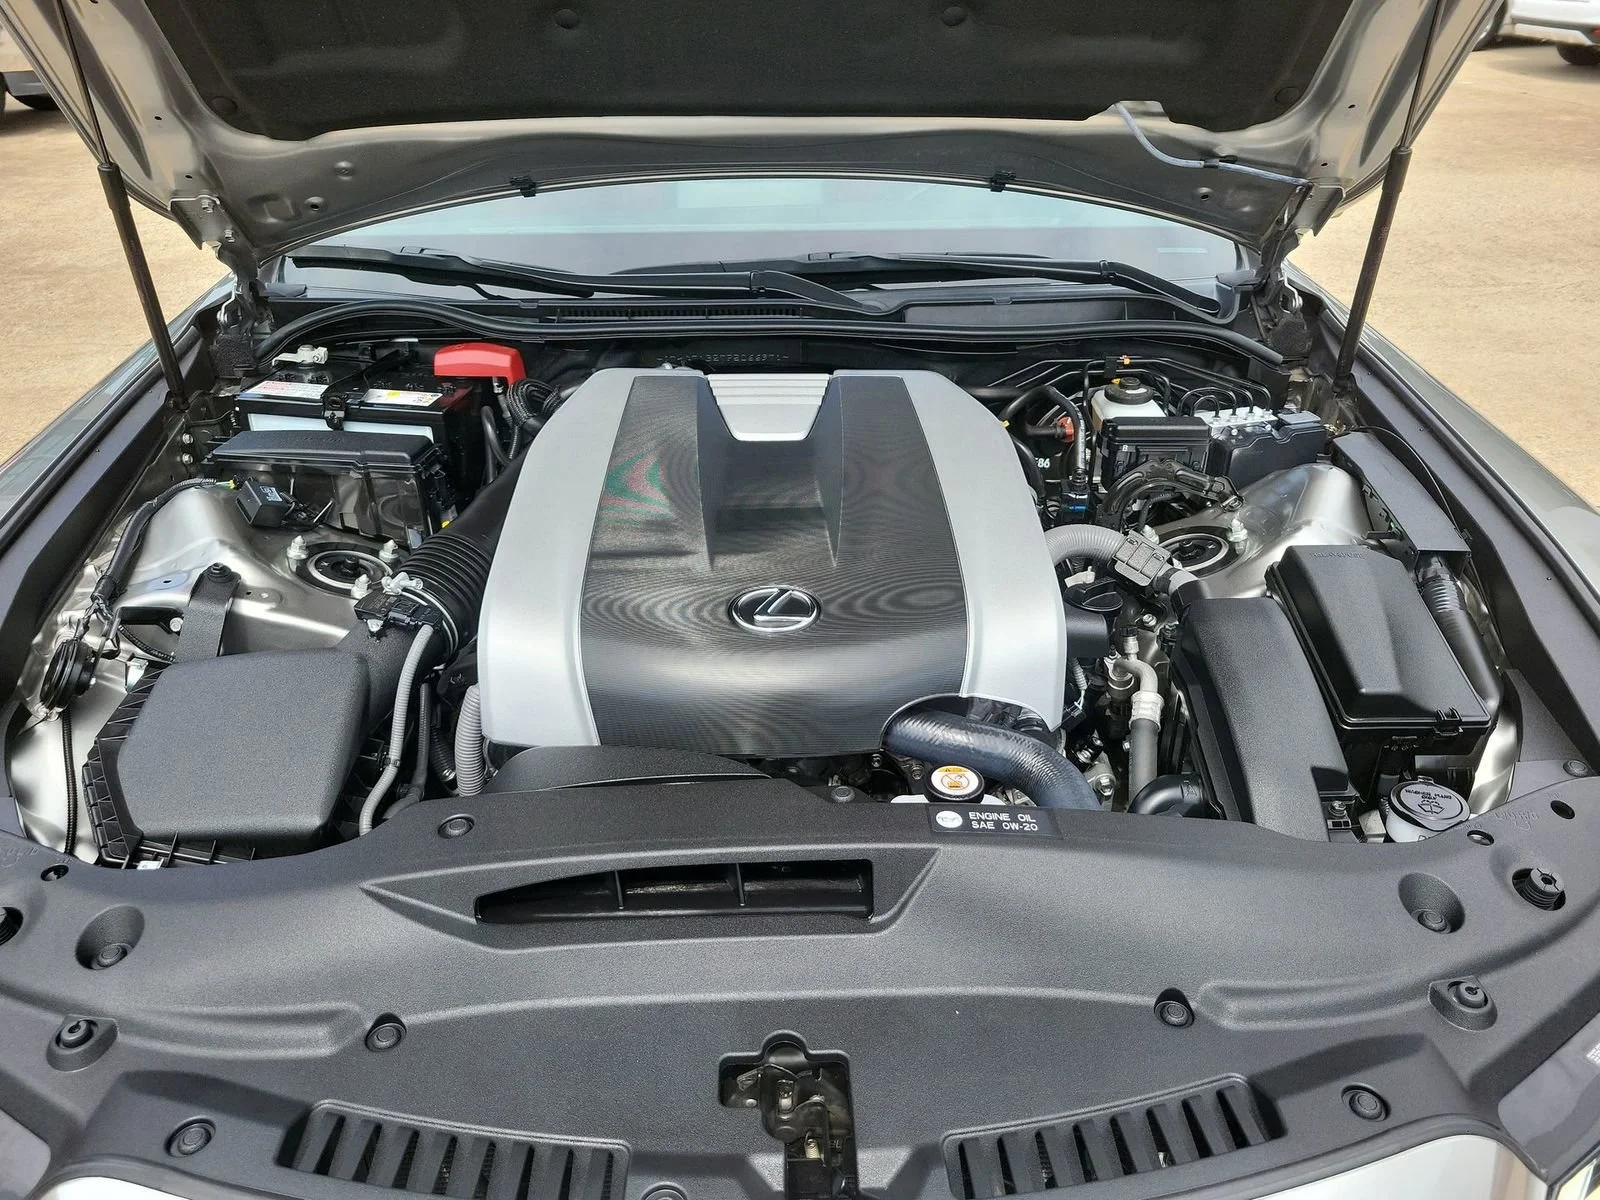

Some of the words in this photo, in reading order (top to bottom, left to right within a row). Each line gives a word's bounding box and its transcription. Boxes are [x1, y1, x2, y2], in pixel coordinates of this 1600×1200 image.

[968, 811, 1011, 821] ENGINE
[1017, 813, 1036, 822] OIL
[971, 820, 995, 829] SAE
[1002, 822, 1038, 831] 0W-20
